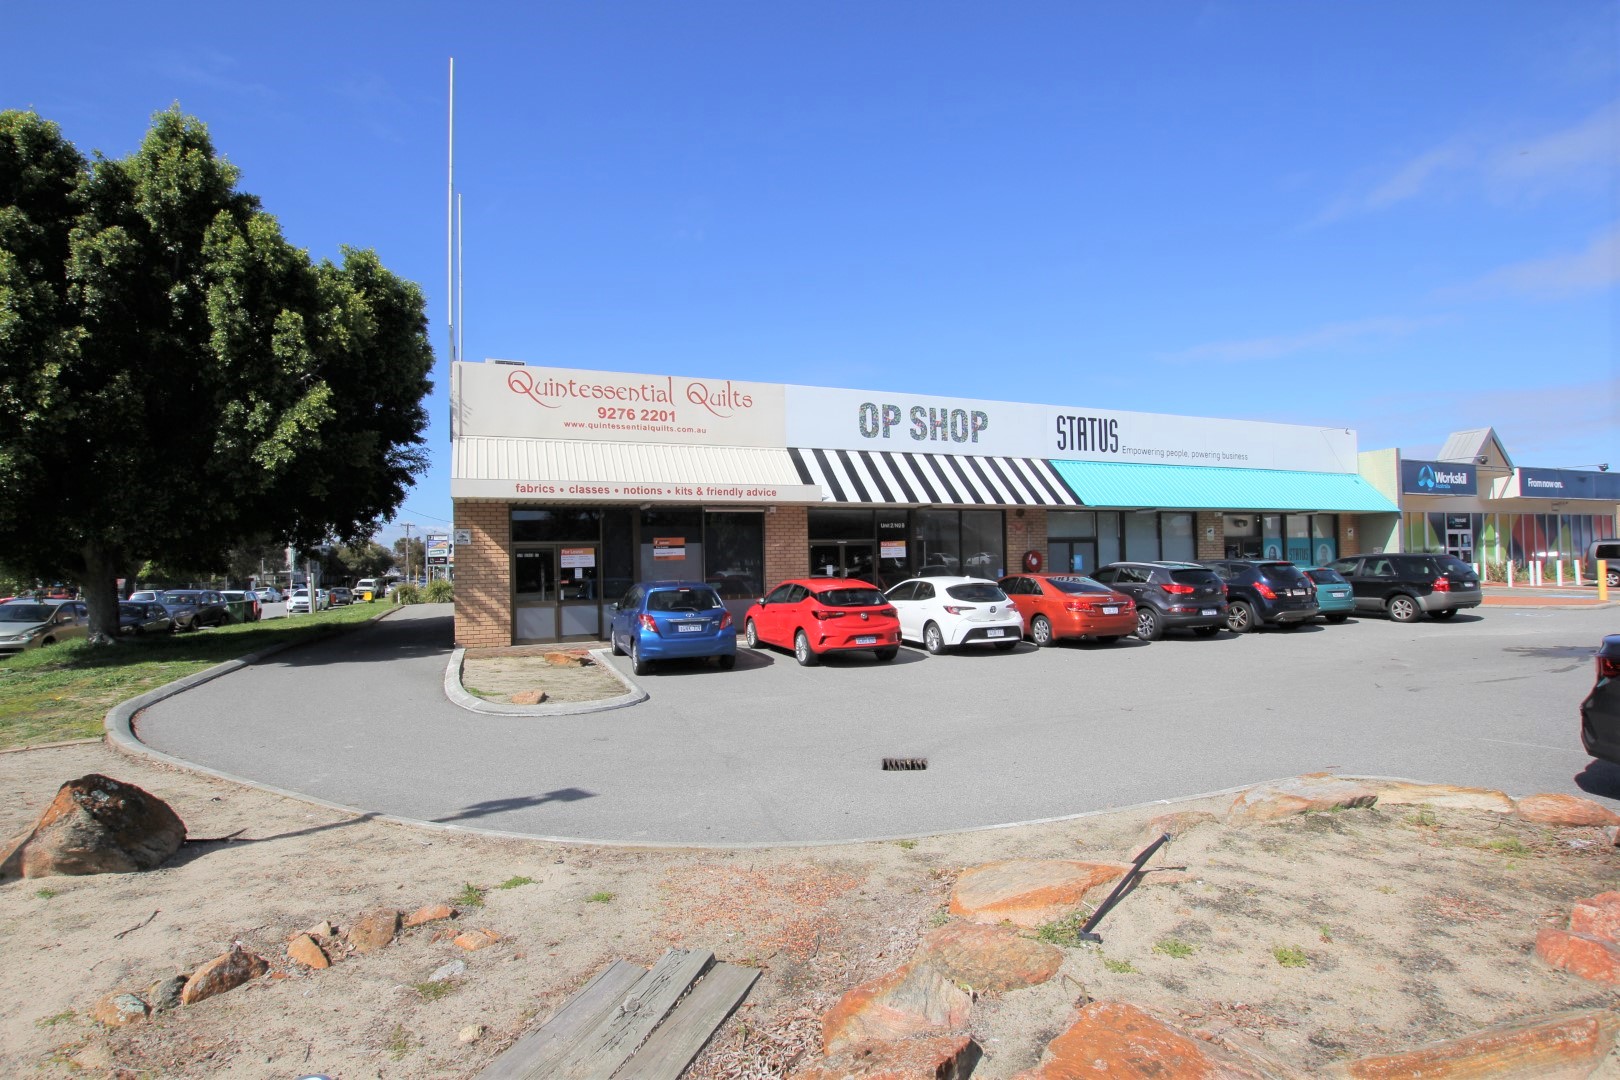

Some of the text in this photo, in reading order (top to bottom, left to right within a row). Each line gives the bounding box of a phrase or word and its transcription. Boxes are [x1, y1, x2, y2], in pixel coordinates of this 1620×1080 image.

[507, 370, 753, 419] Quintessential Quilts
[597, 406, 676, 423] 9276 2201
[858, 402, 989, 443] OP SHOP
[563, 421, 707, 434] www.quintessentialquilts.com.au
[1056, 415, 1119, 453] STATUS
[1121, 445, 1249, 461] Empowering people, powering business
[1527, 477, 1542, 488] From
[1542, 480, 1554, 488] now
[515, 483, 777, 499] fabrics classes notions kits & friendly advice
